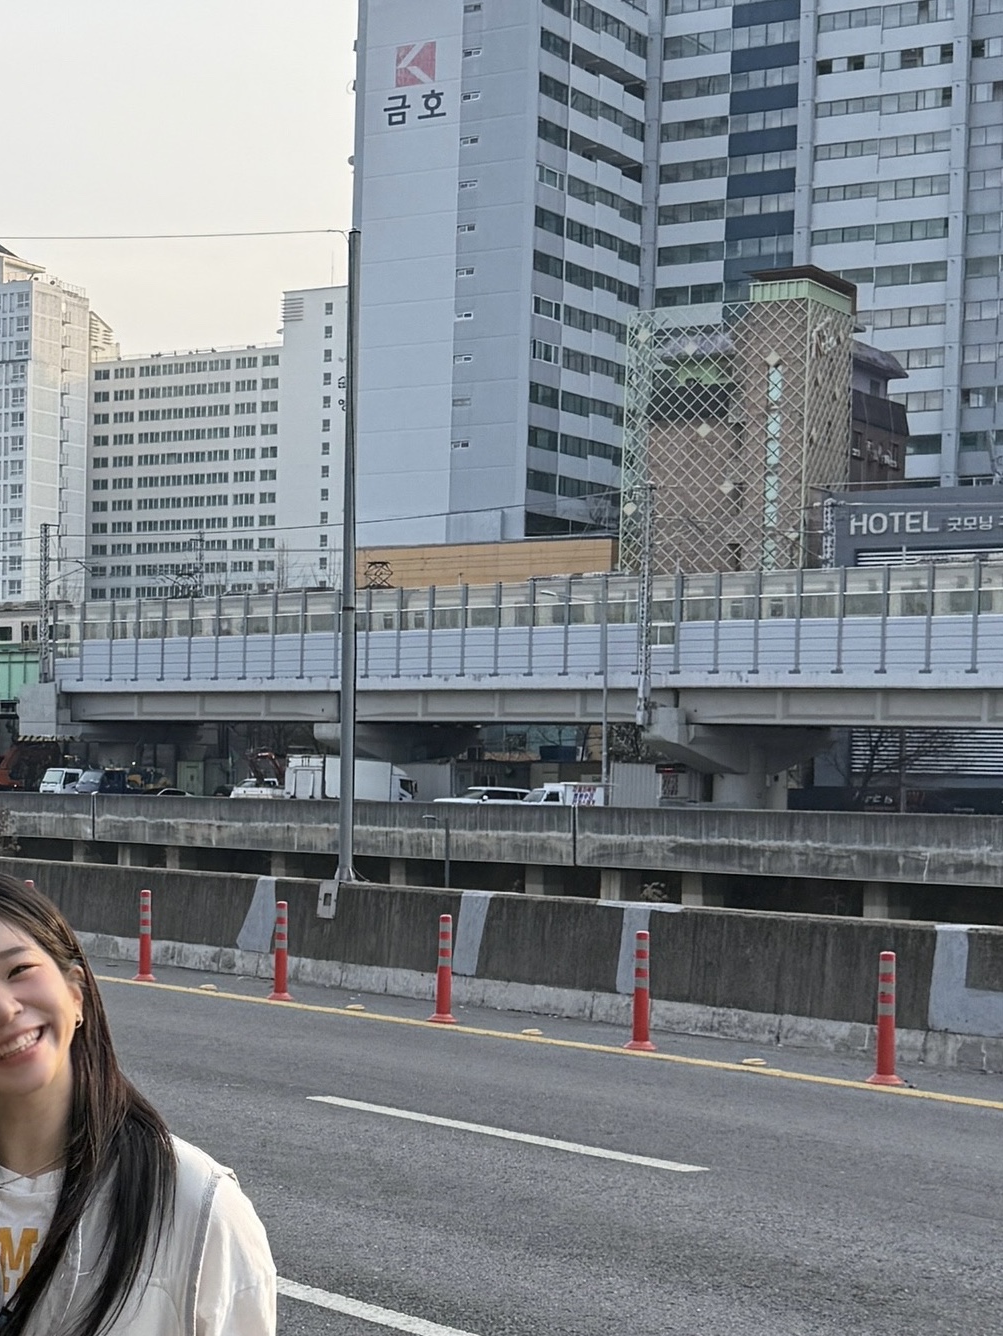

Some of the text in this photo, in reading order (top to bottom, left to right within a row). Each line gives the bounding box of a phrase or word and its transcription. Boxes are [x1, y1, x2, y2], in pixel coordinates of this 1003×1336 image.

[383, 89, 447, 126] 금호
[849, 510, 939, 536] HOTEL
[947, 515, 993, 532] 굿모닝
